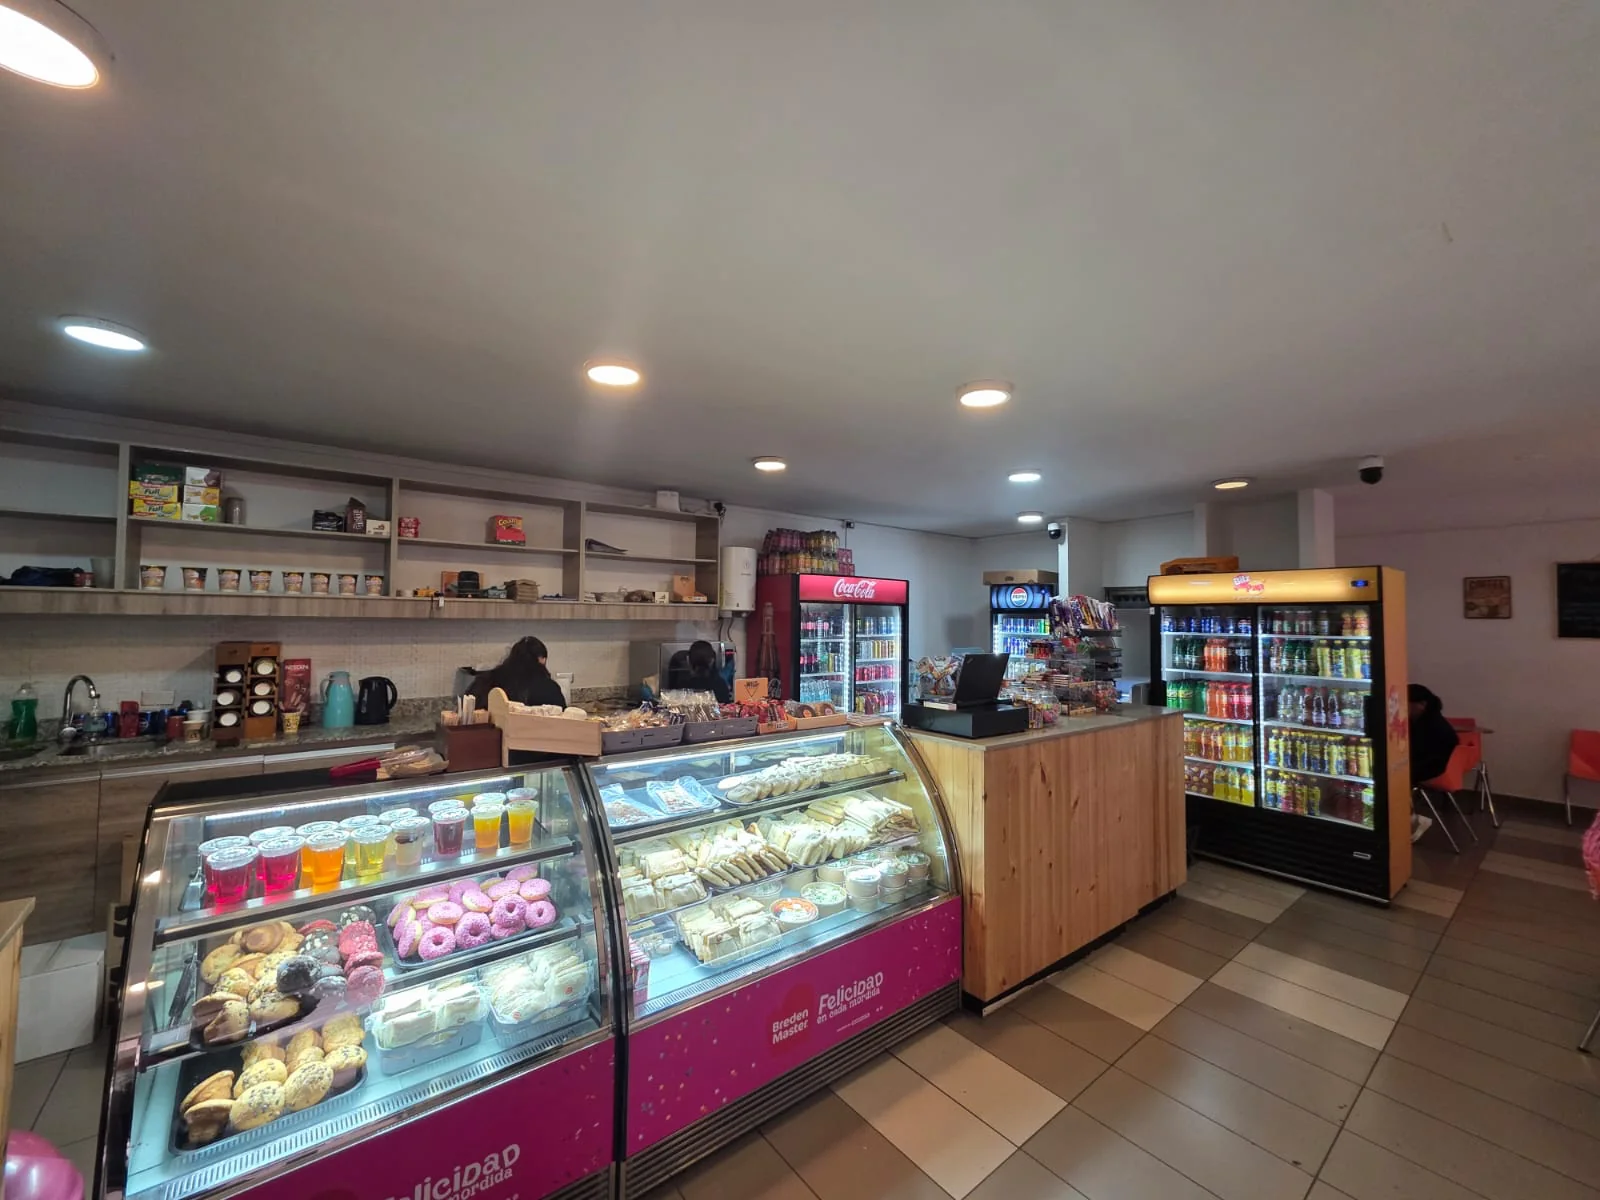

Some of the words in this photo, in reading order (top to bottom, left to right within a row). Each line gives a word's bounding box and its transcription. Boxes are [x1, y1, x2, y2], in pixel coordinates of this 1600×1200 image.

[833, 578, 877, 599] Coca-Cola
[816, 1014, 827, 1025] en
[849, 987, 881, 1008] mordida
[772, 1008, 809, 1033] Breden
[772, 1020, 809, 1045] Master
